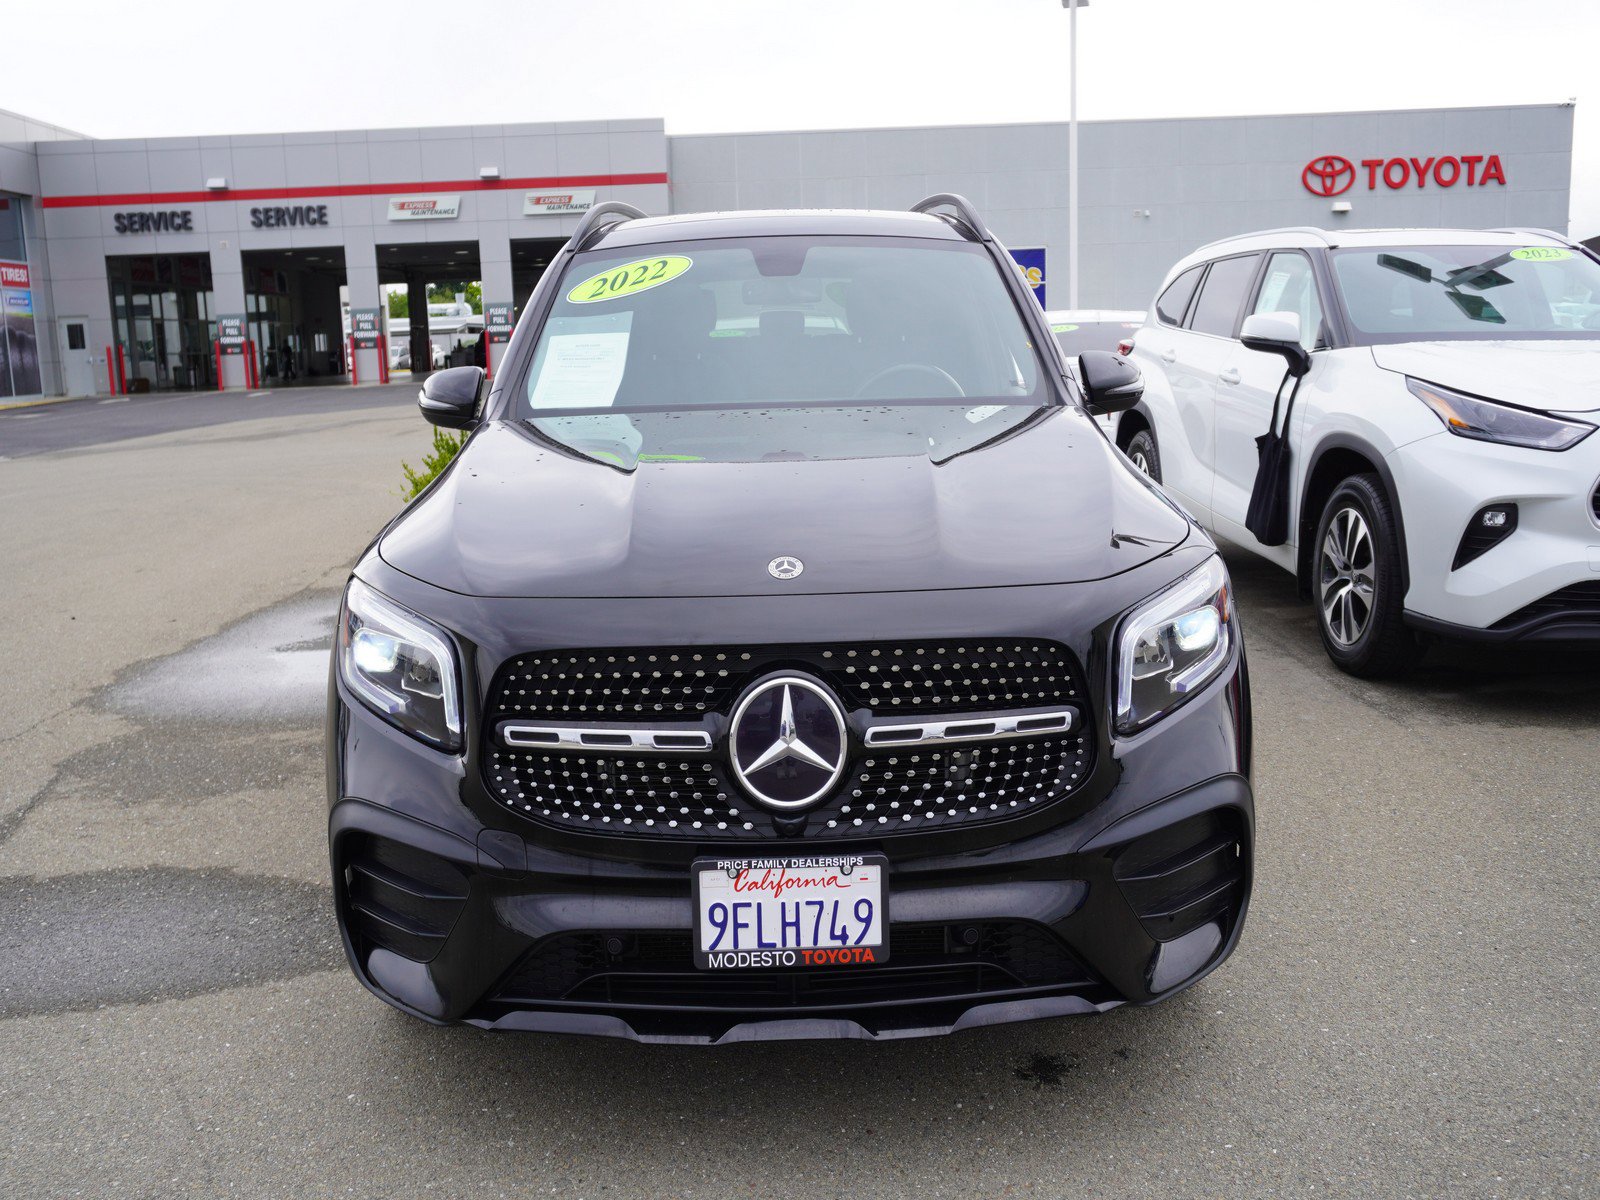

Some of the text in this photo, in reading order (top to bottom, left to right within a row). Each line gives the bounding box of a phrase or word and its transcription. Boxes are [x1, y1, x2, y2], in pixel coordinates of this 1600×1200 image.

[1361, 155, 1506, 190] TOYOTA
[403, 201, 434, 210] EXPRESS
[539, 195, 570, 205] EXPRESS
[410, 208, 456, 216] MAINTENANCE
[545, 203, 591, 211] MAINTENANCE
[114, 210, 193, 234] SERVICE
[250, 205, 329, 228] SERVICE
[1521, 248, 1562, 259] 2023
[1, 266, 28, 283] TIRES!
[587, 259, 669, 300] 2022
[490, 307, 507, 315] PLEASE
[222, 318, 240, 327] PLEASE
[360, 321, 371, 330] PULL
[492, 316, 505, 324] PULL
[226, 327, 238, 335] PULL
[717, 857, 863, 870] PRICE FAMILY DEALERSHIPS
[733, 868, 851, 898] California
[708, 898, 873, 951] 9FLH749
[708, 948, 875, 968] MODESTO TOYOTA
